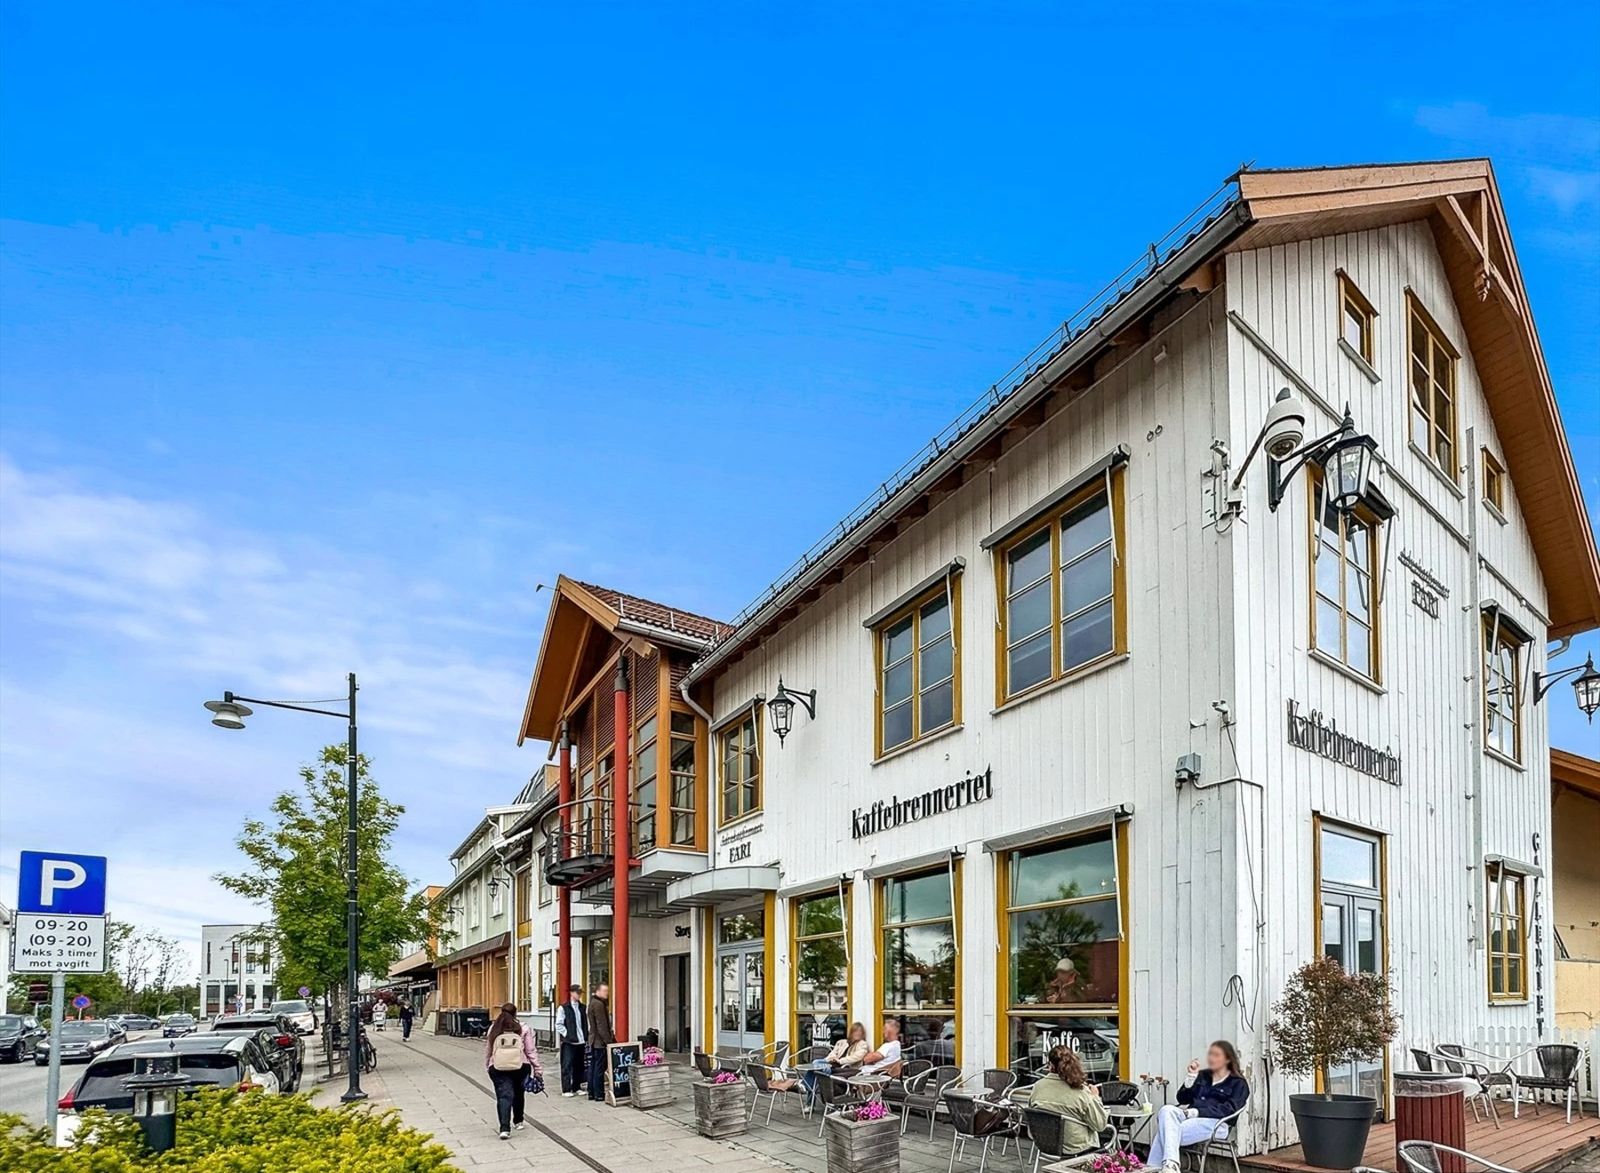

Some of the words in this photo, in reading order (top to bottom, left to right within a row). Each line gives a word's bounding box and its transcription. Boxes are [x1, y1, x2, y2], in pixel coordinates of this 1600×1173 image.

[1287, 698, 1402, 787] Kaffebrenneriet
[852, 764, 993, 839] Kaffebrenneriet
[40, 859, 86, 906] P
[35, 919, 88, 931] 09-20
[30, 934, 91, 947] (09-20)
[22, 948, 52, 956] Maks
[57, 949, 64, 957] 3
[68, 949, 97, 957] timer
[56, 960, 89, 969] avgift
[813, 1023, 831, 1039] Kaffe
[1042, 1031, 1080, 1053] Kaffe
